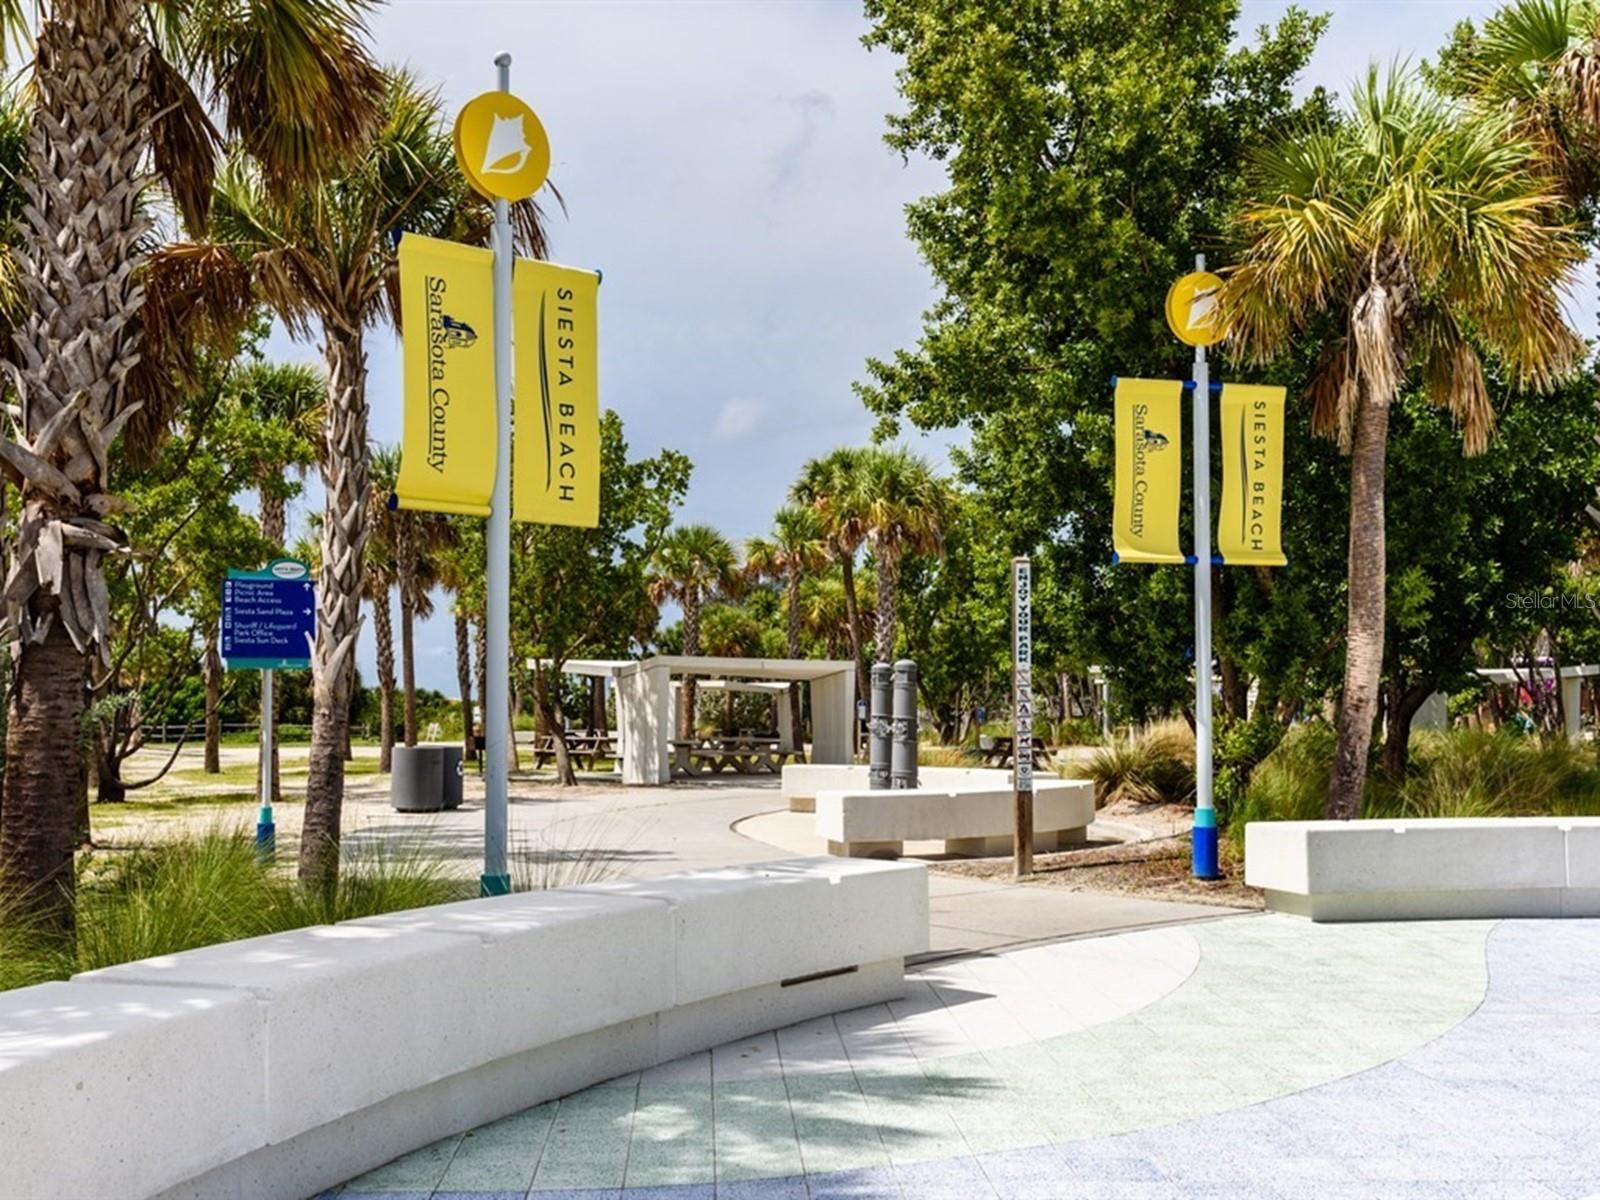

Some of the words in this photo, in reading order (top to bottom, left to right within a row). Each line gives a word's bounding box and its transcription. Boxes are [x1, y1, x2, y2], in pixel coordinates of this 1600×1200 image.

[429, 277, 447, 382] Sarasota
[557, 287, 575, 386] SIESTA
[427, 388, 450, 474] County
[558, 404, 576, 502] BEACH
[1135, 404, 1148, 476] Sarasota
[1252, 400, 1266, 471] SIESTA
[1129, 480, 1148, 538] County
[1251, 482, 1265, 551] BEACH
[234, 582, 274, 590] Playground
[1018, 568, 1028, 601] ENJOY
[1018, 605, 1028, 633] YOUR
[1018, 636, 1028, 663] PARK
